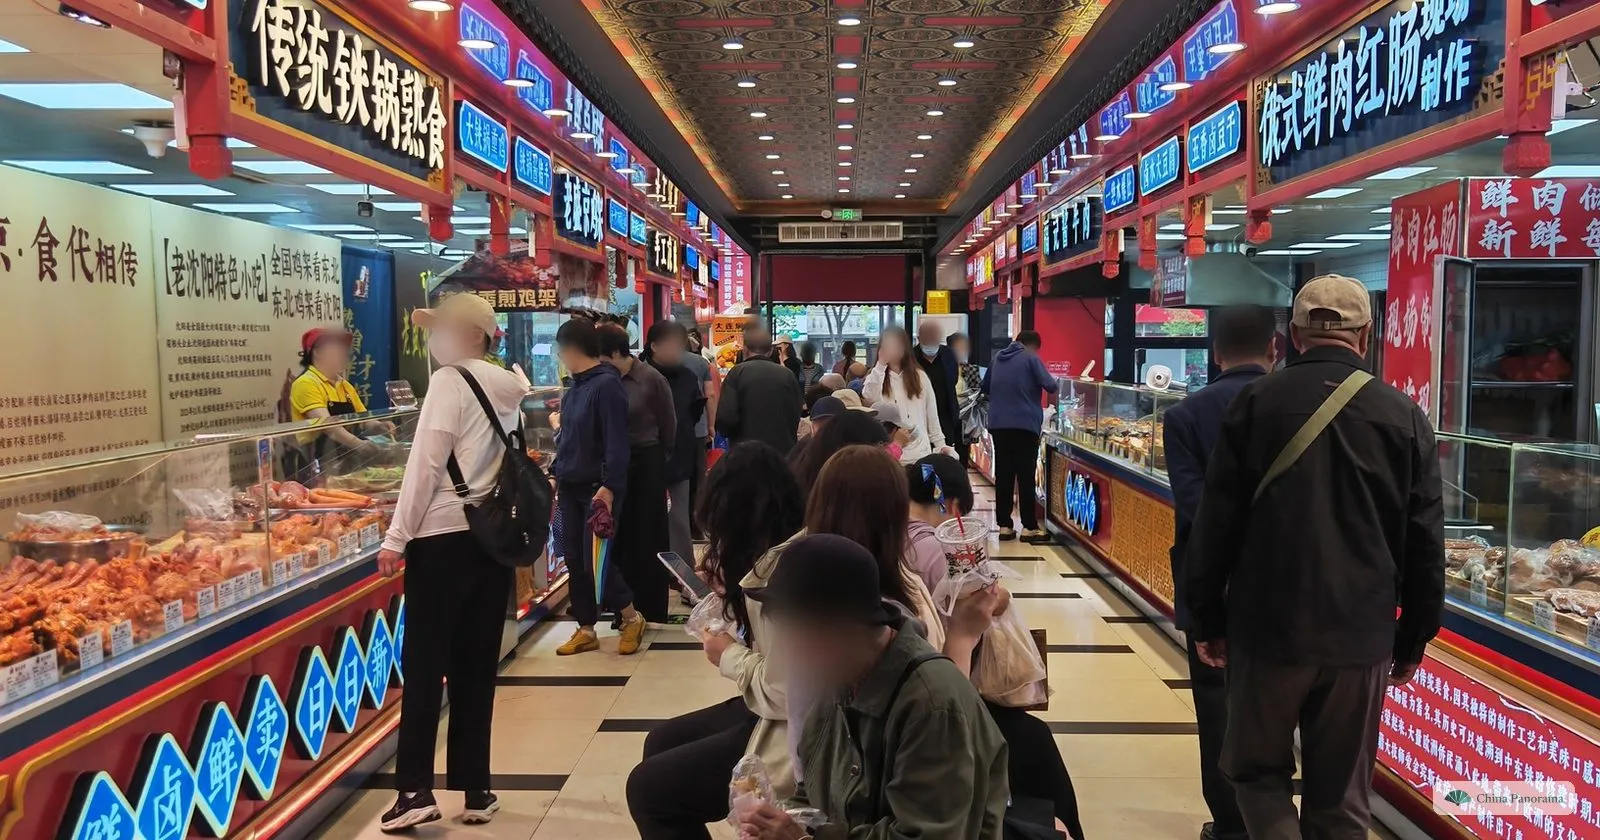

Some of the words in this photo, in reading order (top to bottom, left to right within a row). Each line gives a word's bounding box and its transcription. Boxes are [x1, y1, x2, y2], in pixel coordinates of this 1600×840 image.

[252, 0, 447, 169] 传统铁锅熟食
[1259, 1, 1421, 167] 俄式鲜肉红肠
[1420, 38, 1471, 112] 制作
[270, 243, 340, 286] 全国鸡架看东北
[1391, 201, 1457, 270] 鲜肉红肠
[164, 238, 268, 303] 【老沈阳特色小吃】
[468, 288, 557, 308] 香煎鸡架
[272, 289, 342, 321] 东北鸡架看沈阳
